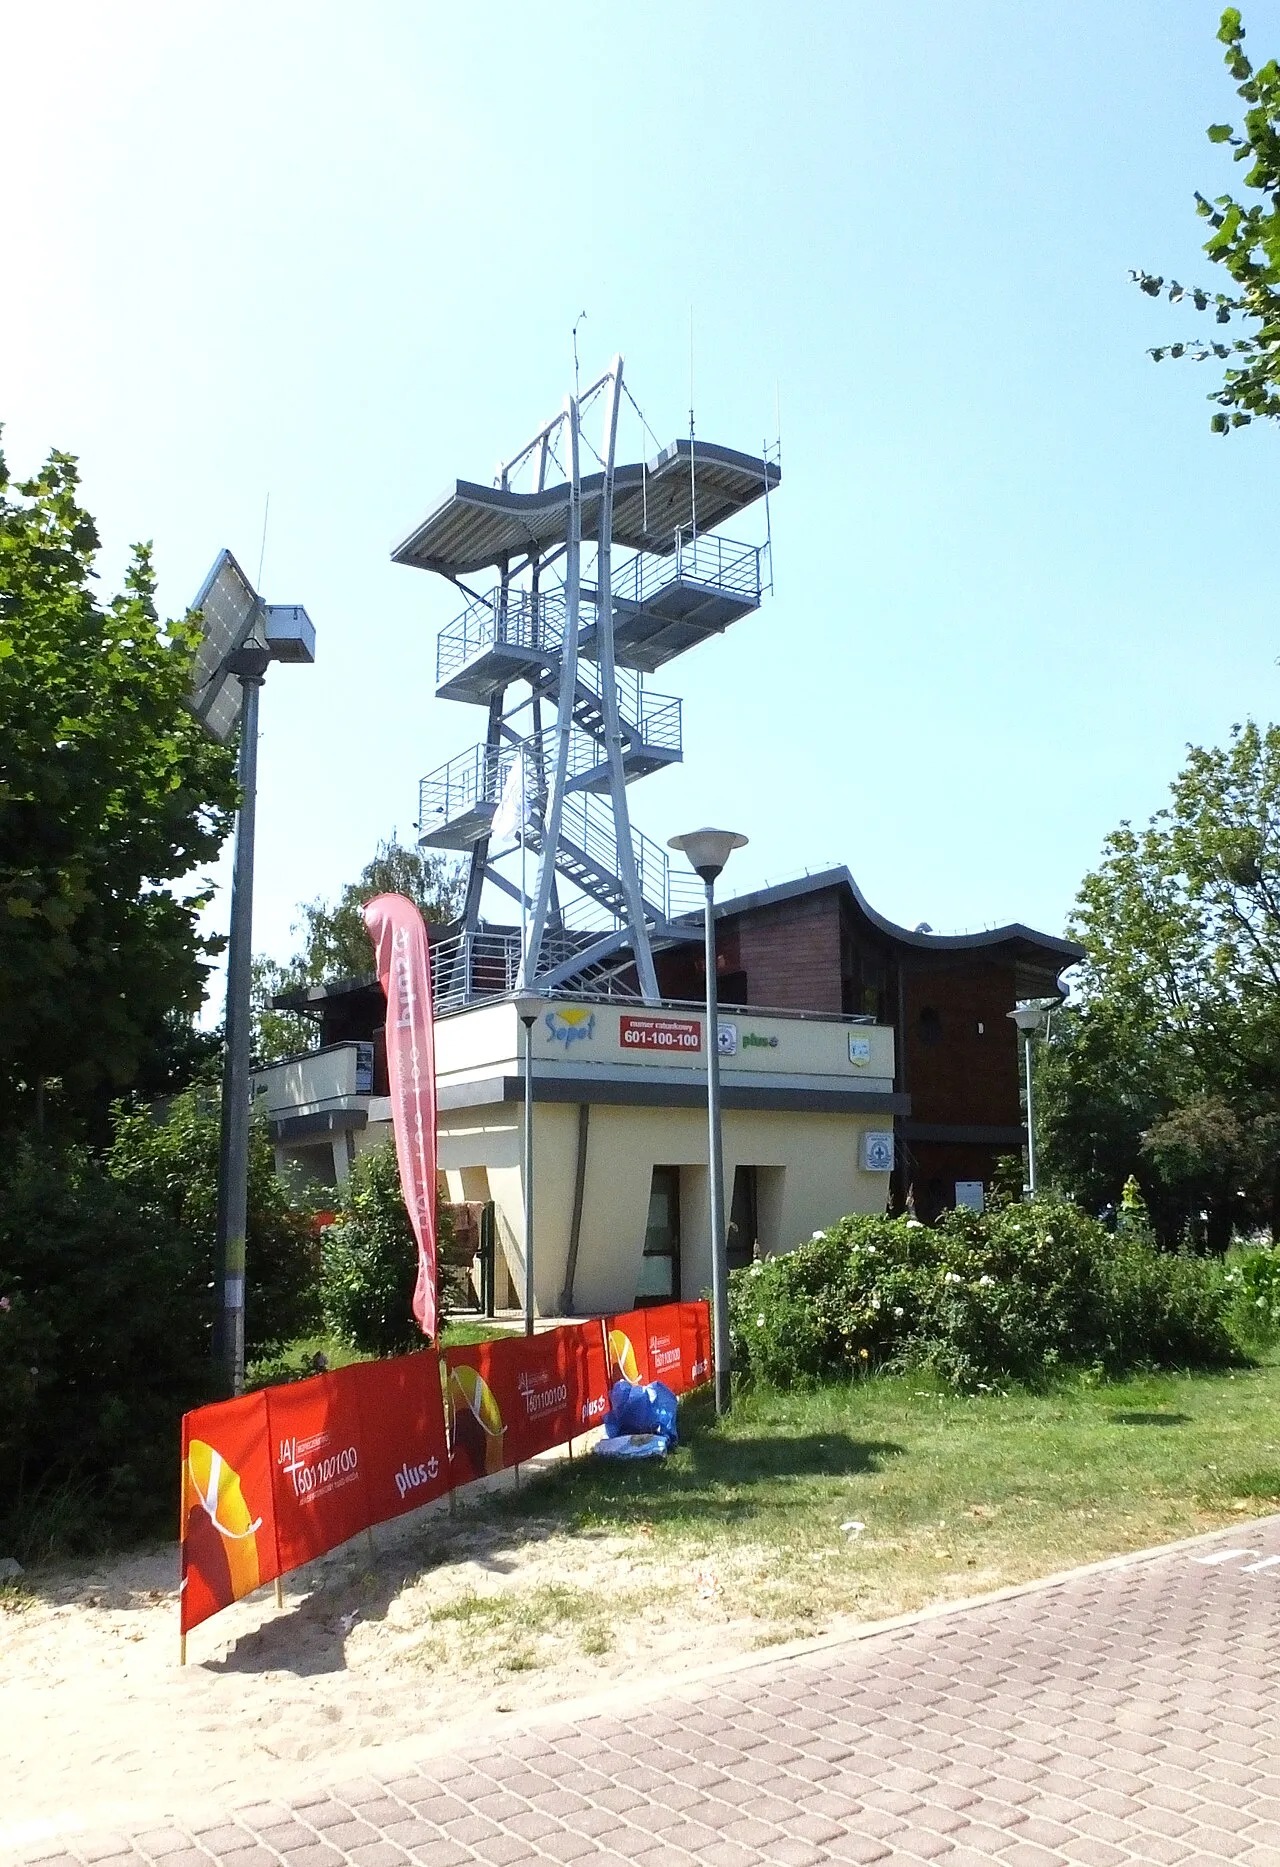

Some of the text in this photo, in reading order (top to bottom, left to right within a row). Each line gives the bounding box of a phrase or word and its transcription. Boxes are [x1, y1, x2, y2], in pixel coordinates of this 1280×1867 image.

[545, 1012, 596, 1050] Sopot
[624, 1030, 699, 1047] 601-100-100
[582, 1398, 598, 1424] plus
[298, 1446, 358, 1494] 601100100
[395, 1462, 428, 1499] plus
